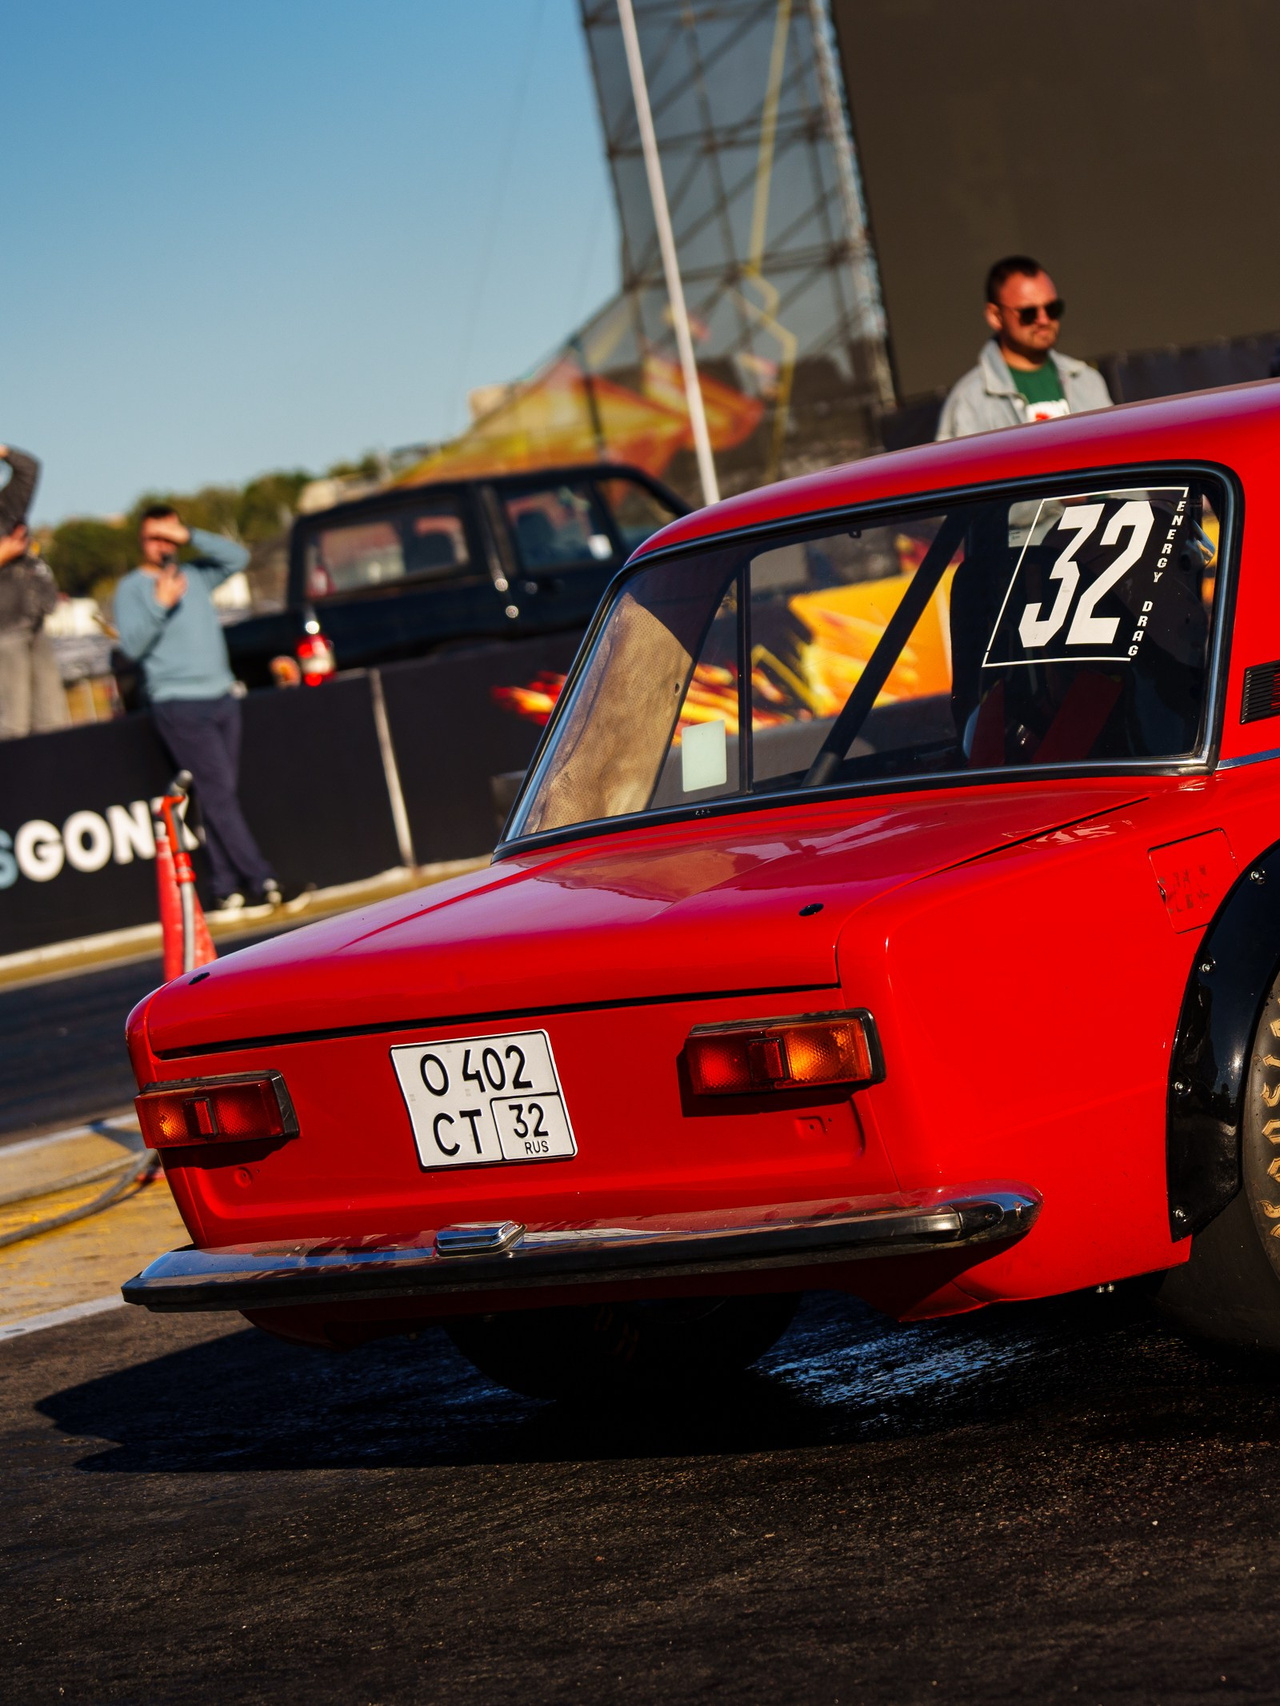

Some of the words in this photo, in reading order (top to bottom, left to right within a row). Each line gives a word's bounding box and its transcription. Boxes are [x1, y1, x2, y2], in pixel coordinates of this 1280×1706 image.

[1153, 501, 1186, 583] ENERGY
[1018, 501, 1155, 648] 32
[1128, 601, 1153, 656] DRAG
[462, 1045, 533, 1093] 402
[509, 1103, 549, 1139] 32
[525, 1140, 549, 1155] RUS
